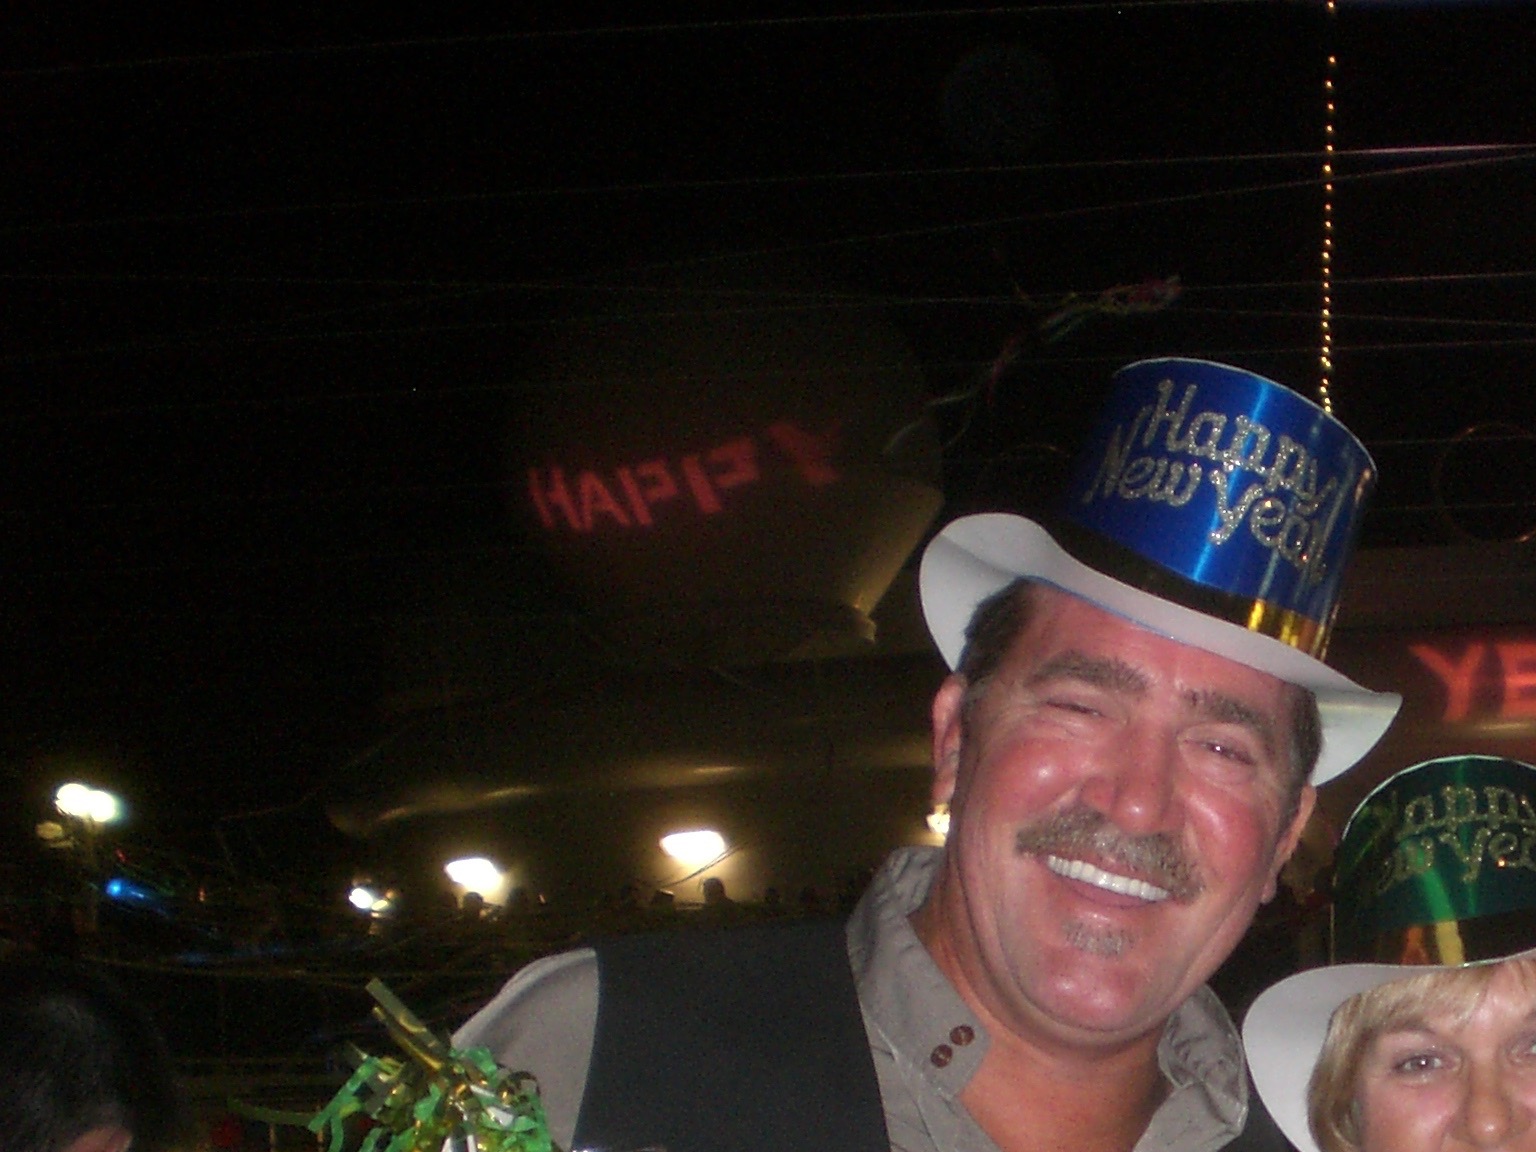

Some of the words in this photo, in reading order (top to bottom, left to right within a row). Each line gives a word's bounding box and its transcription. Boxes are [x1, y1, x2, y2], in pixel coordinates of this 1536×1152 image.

[526, 418, 842, 533] HAPPY
[1083, 404, 1203, 508] New
[1142, 378, 1338, 516] Happy
